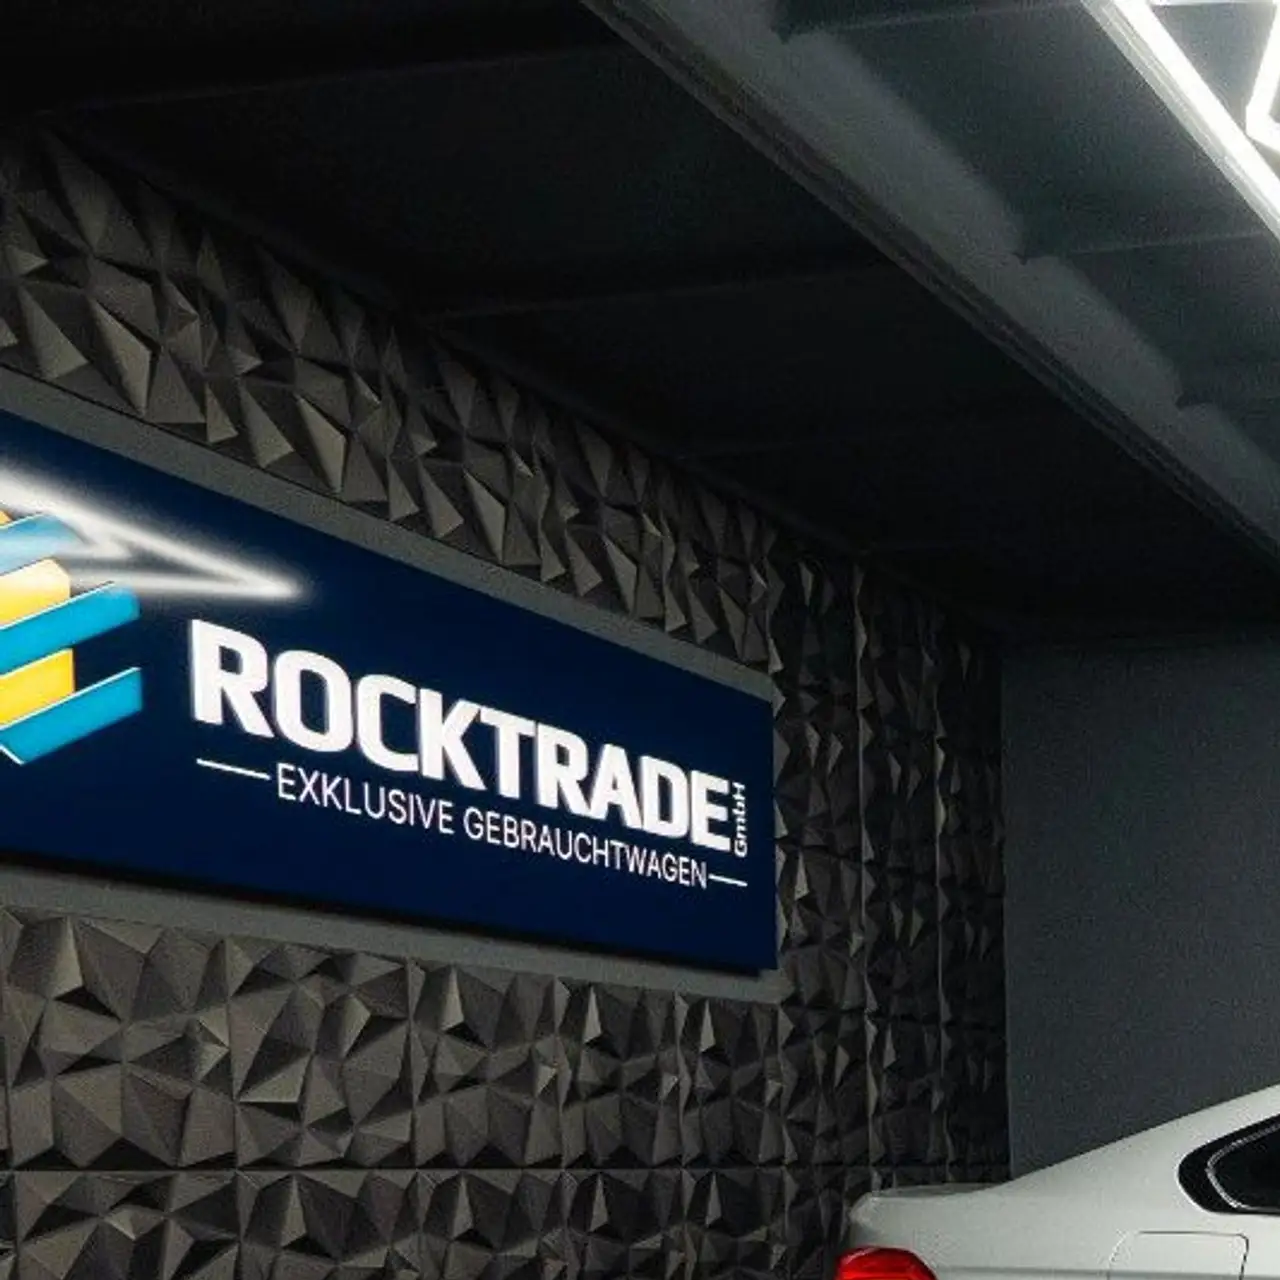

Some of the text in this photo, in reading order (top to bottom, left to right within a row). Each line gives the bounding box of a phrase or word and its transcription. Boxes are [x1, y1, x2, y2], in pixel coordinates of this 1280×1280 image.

[191, 618, 732, 852] ROCKTRADE
[277, 762, 707, 889] EXKLUSIVE GEBRAUCHTWAGEN
[731, 781, 748, 858] GmbH
